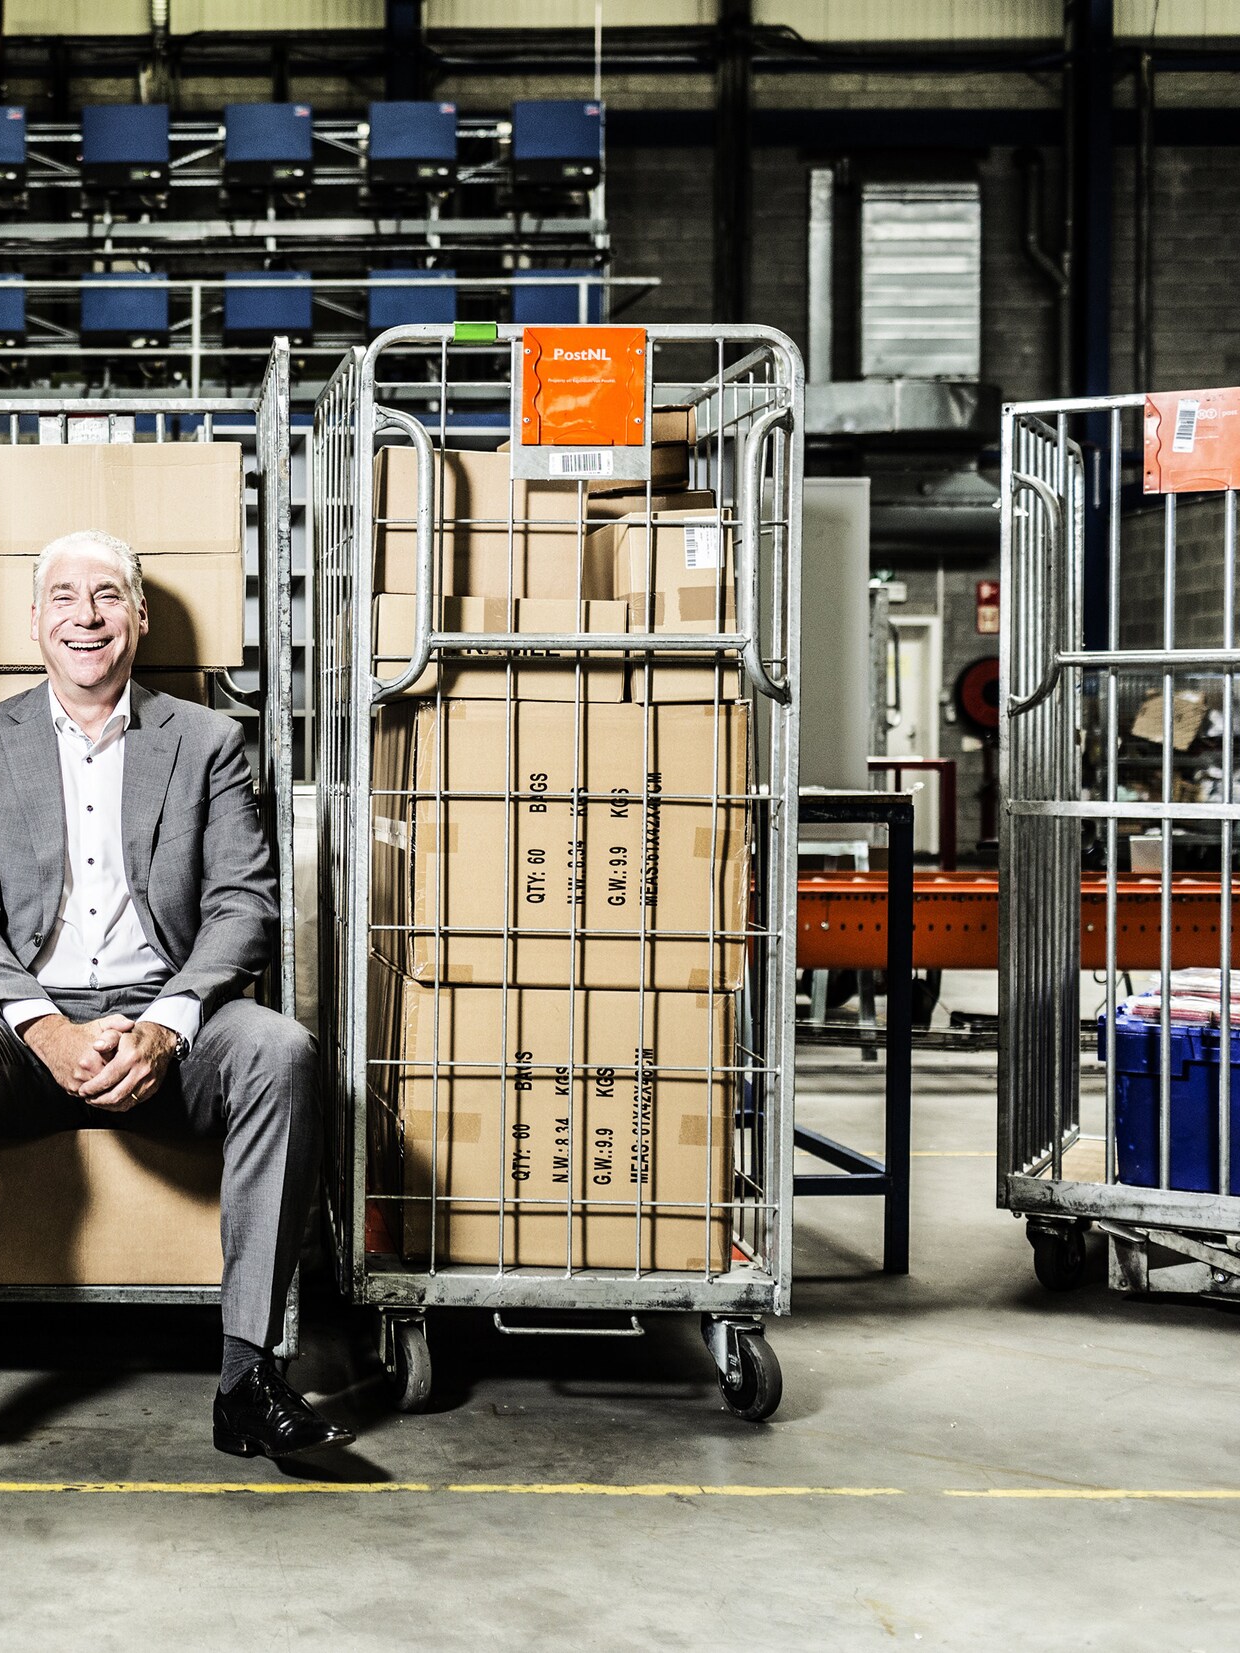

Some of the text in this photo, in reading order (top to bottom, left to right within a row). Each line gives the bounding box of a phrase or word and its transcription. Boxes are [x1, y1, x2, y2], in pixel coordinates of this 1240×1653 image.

[553, 348, 611, 361] PostNL
[610, 788, 629, 818] KGS
[526, 773, 548, 903] QTY: 60 BAGS
[555, 1067, 569, 1095] KGS
[596, 1067, 615, 1098] KGS
[511, 1051, 533, 1181] QTY: 60 BAGS
